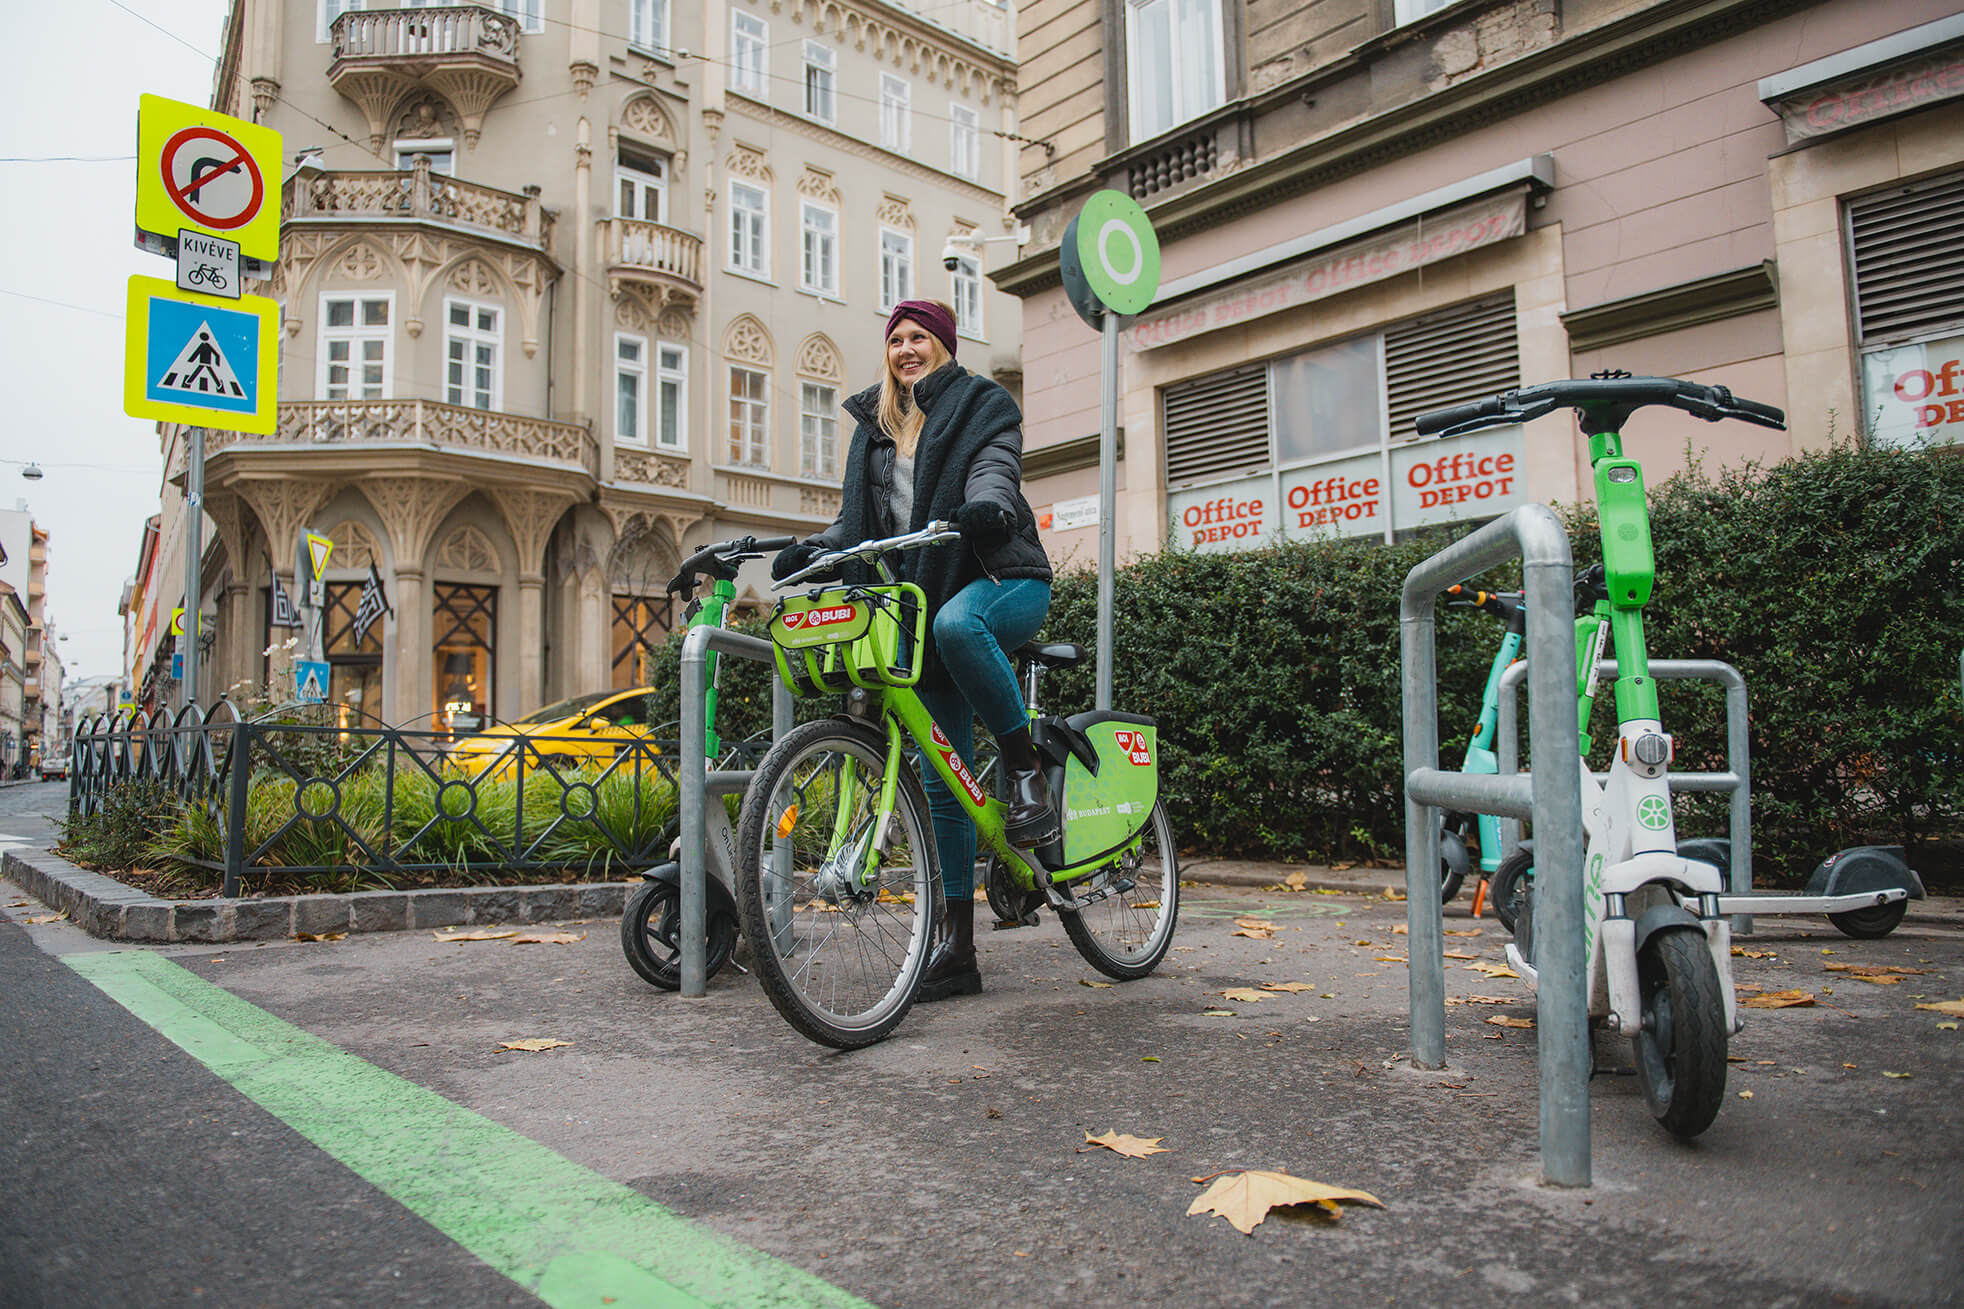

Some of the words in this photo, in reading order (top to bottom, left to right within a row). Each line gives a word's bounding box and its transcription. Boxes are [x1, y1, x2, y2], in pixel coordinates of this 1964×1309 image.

[1135, 308, 1208, 346] Office
[1214, 286, 1291, 321] DEPOT
[1304, 249, 1401, 294] Office
[1408, 213, 1507, 263] DEPOT
[1407, 452, 1515, 489] Office
[1287, 476, 1380, 510] Office
[1418, 476, 1514, 509] DEPOT
[1183, 497, 1264, 528] Office
[1297, 499, 1379, 529] DEPOT
[1192, 519, 1263, 546] DEPOT
[821, 608, 851, 622] BUBI
[1131, 751, 1151, 764] BUBI
[959, 767, 983, 802] BUBI
